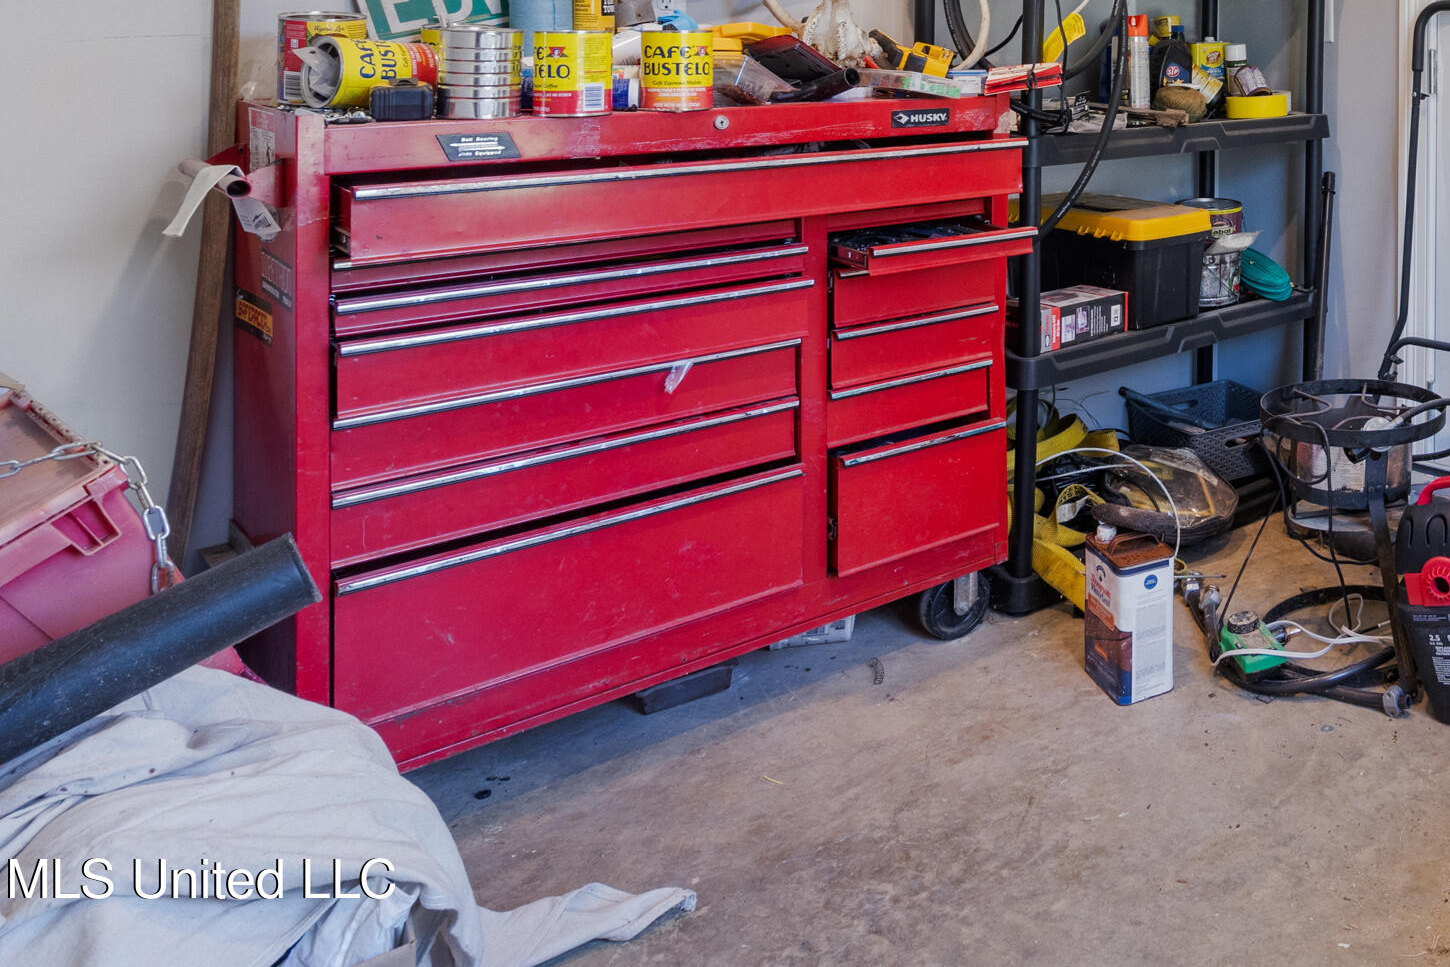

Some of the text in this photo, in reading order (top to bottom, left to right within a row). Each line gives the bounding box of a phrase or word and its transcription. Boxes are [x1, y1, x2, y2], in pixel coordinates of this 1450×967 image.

[643, 61, 710, 76] BUSTELO
[910, 113, 947, 123] HUSKY
[1213, 227, 1232, 235] abot
